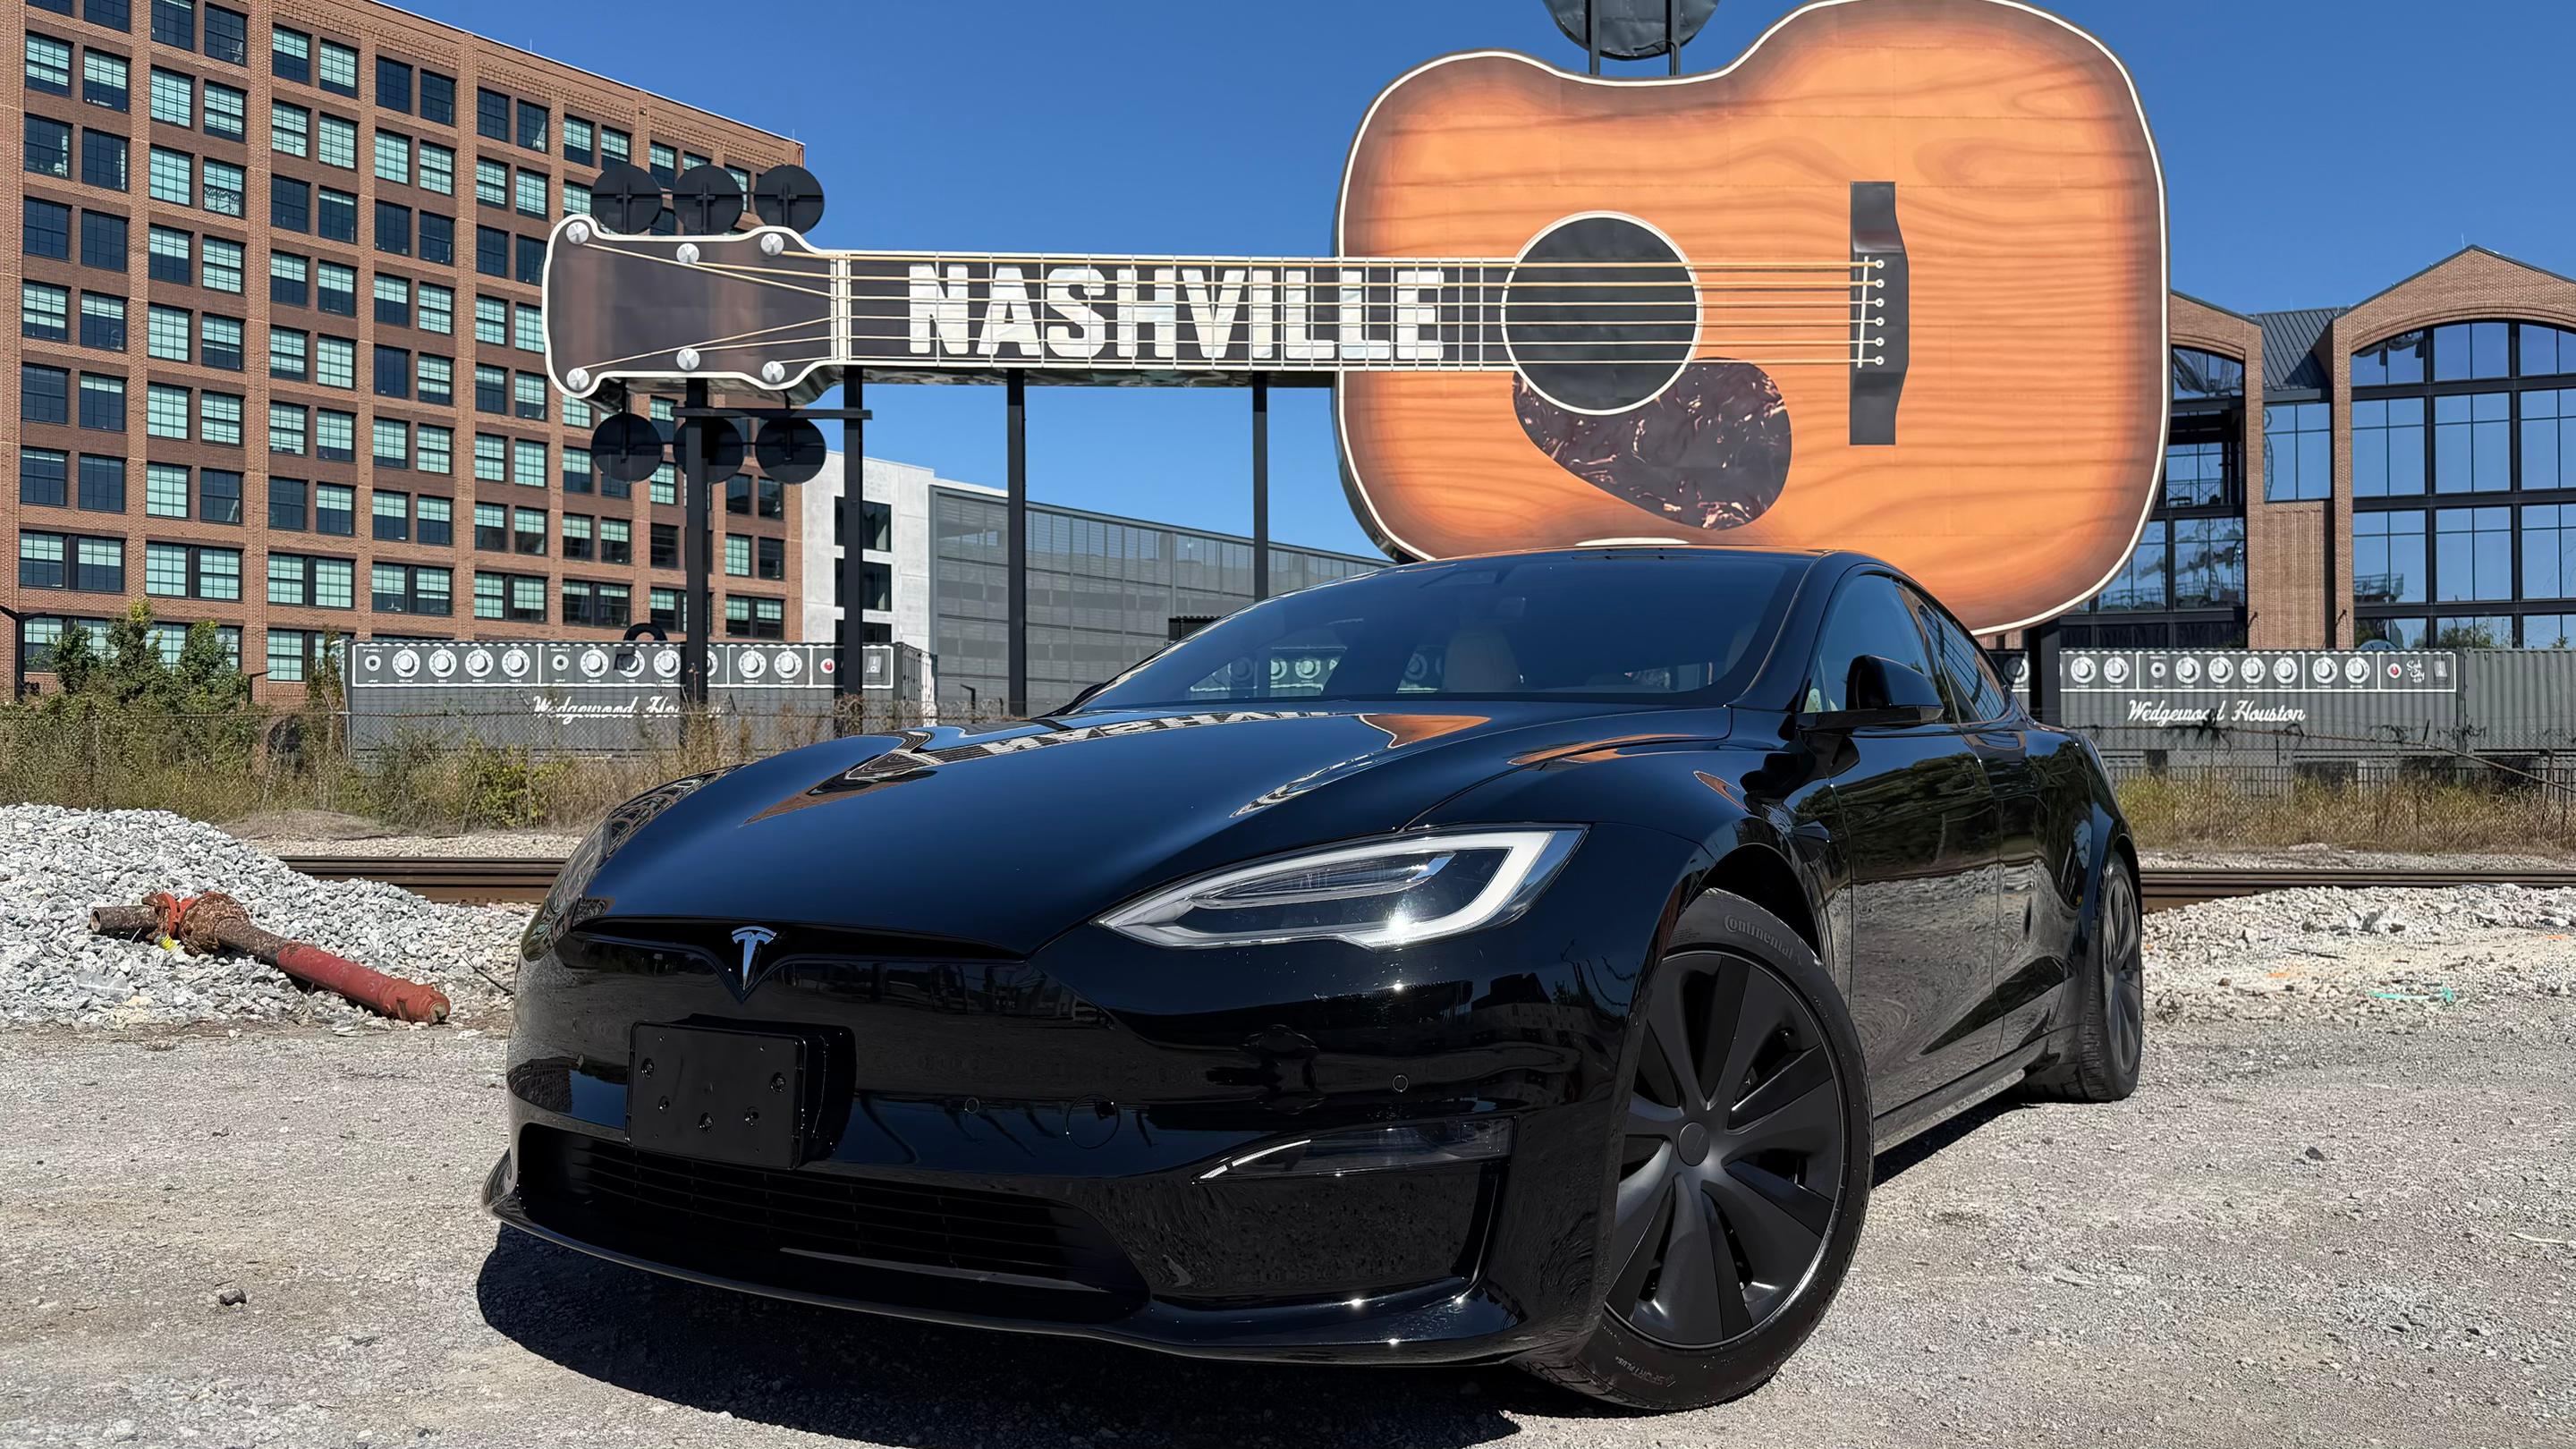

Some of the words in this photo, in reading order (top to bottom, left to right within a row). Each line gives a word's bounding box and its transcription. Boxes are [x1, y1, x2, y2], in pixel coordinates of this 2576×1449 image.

[909, 263, 1445, 360] NASHVILLE
[2231, 699, 2306, 722] Houston
[1724, 914, 1794, 961] Continental
